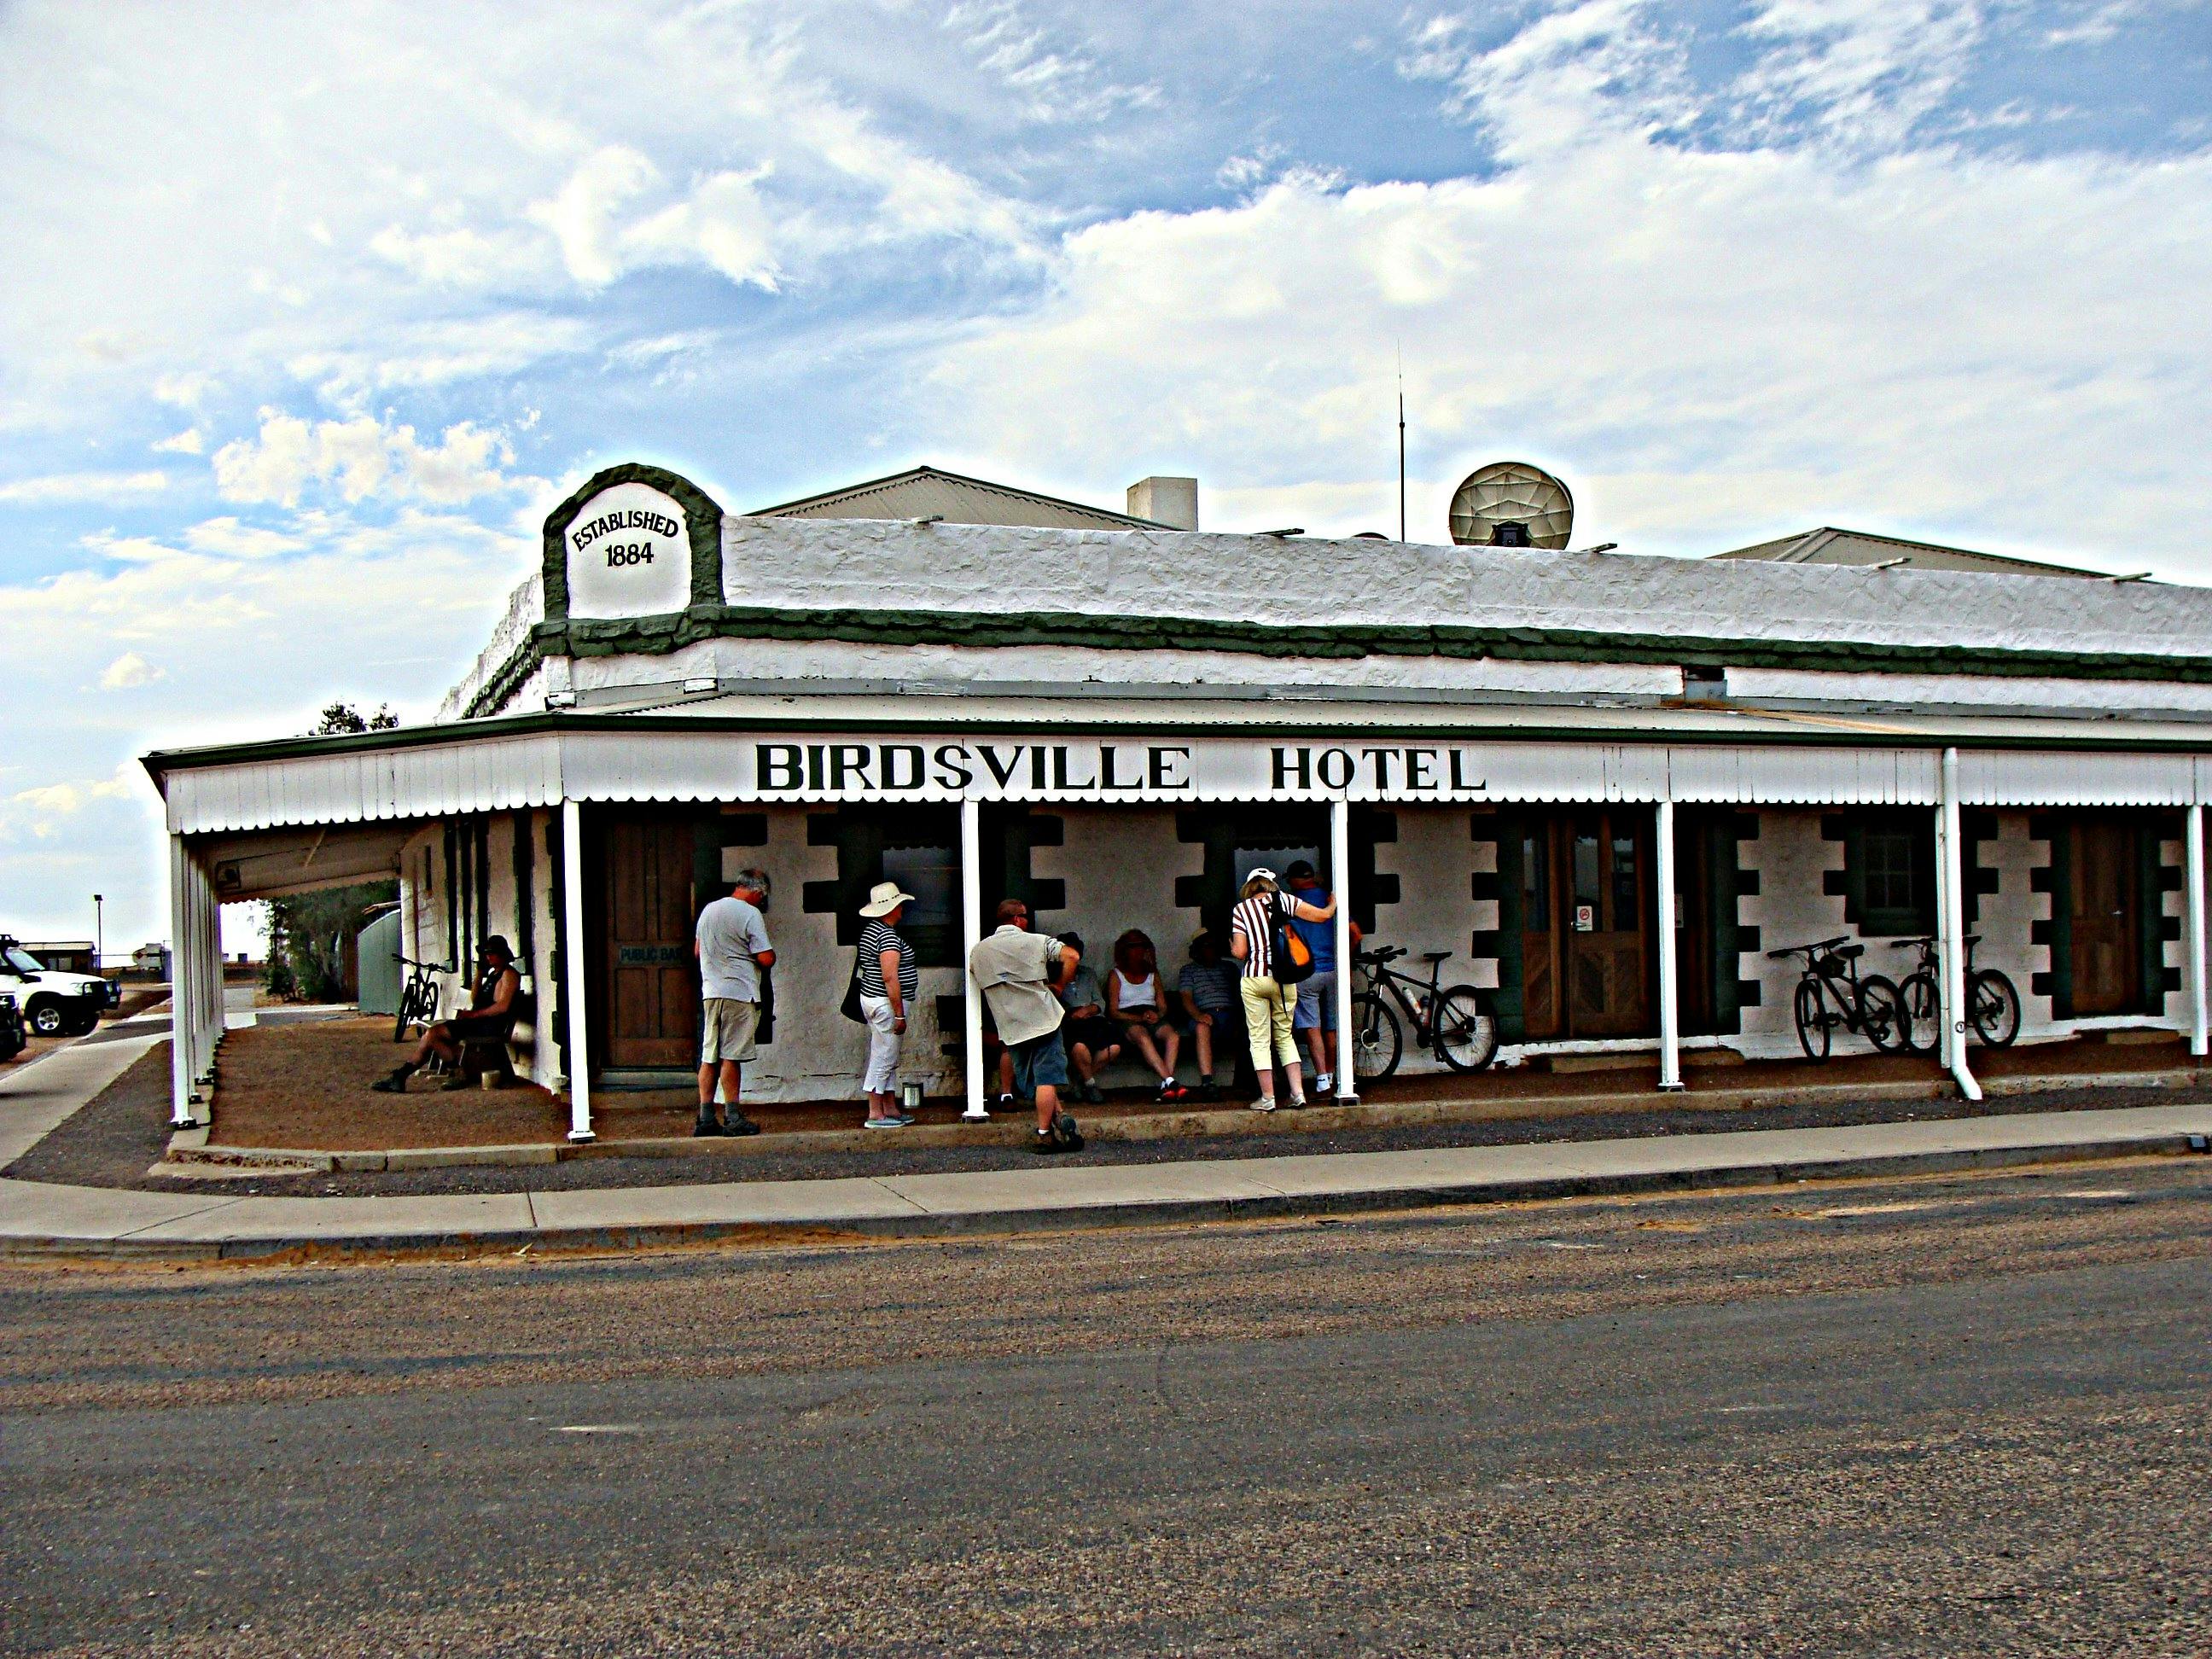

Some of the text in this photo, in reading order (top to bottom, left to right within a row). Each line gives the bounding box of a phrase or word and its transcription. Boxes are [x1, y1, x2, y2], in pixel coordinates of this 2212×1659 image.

[572, 510, 678, 552] ESTABLISHED
[605, 542, 654, 567] 1884
[755, 743, 1487, 791] BIRDSVILLE HOTEL
[620, 946, 657, 960] PUBLIC
